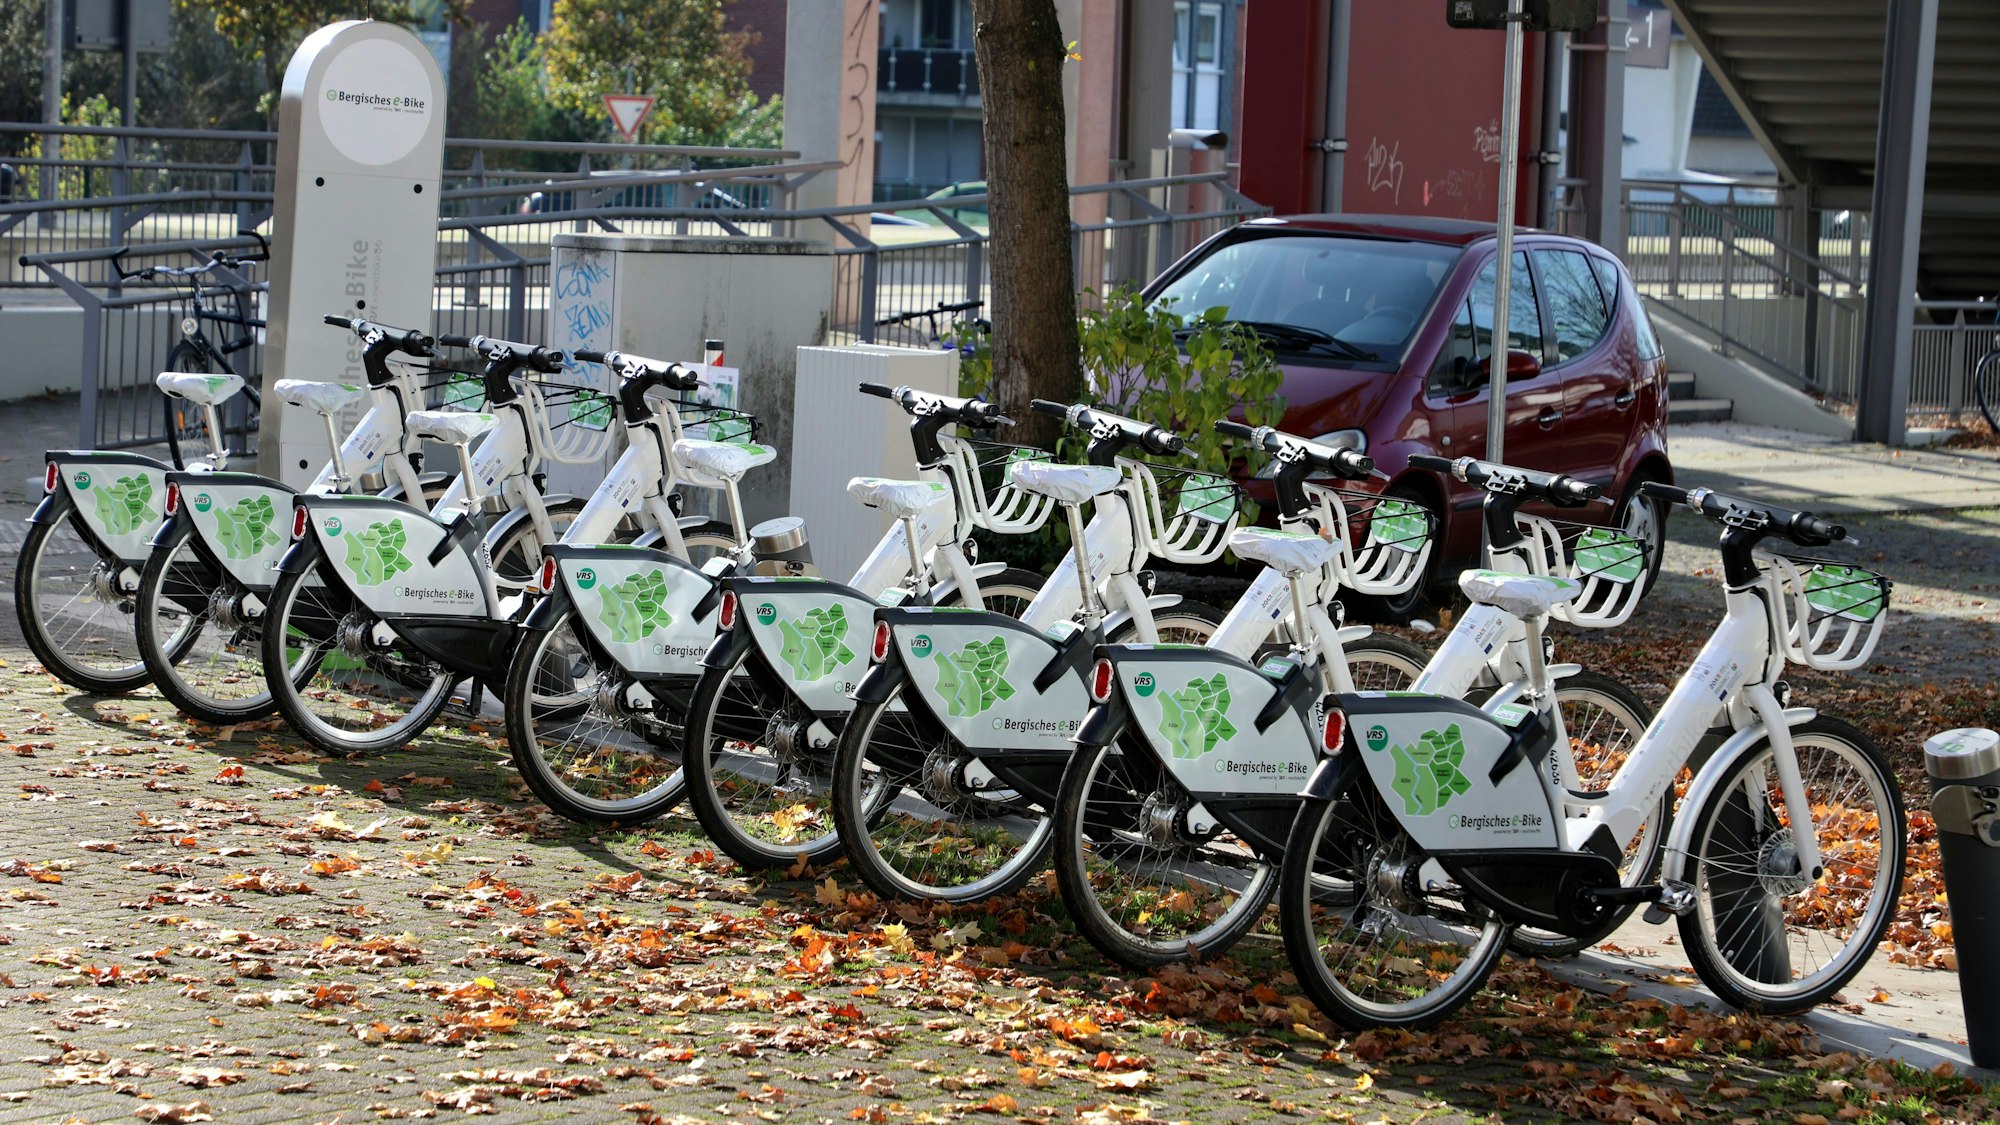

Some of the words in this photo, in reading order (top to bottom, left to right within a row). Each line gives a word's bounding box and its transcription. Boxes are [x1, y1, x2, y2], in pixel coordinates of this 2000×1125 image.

[1645, 11, 1653, 48] 1
[339, 91, 391, 105] Bergisches
[393, 96, 425, 108] e-Bike
[324, 520, 338, 528] VRS
[577, 572, 592, 580] VRS
[404, 587, 448, 600] Bergisches
[449, 588, 474, 600] e-Bike
[756, 607, 772, 615] VRS
[911, 639, 927, 648] VRS
[664, 645, 708, 658] Bergische
[1135, 677, 1150, 686] VRS
[1315, 702, 1324, 733] 4261
[1004, 718, 1056, 732] Bergisches
[1058, 720, 1082, 731] e-Bi
[1366, 730, 1383, 740] VRS
[1226, 760, 1276, 775] Bergisches
[1277, 762, 1307, 773] e-Bike
[1460, 814, 1510, 830] Bergisches
[1512, 815, 1542, 826] e-Bike
